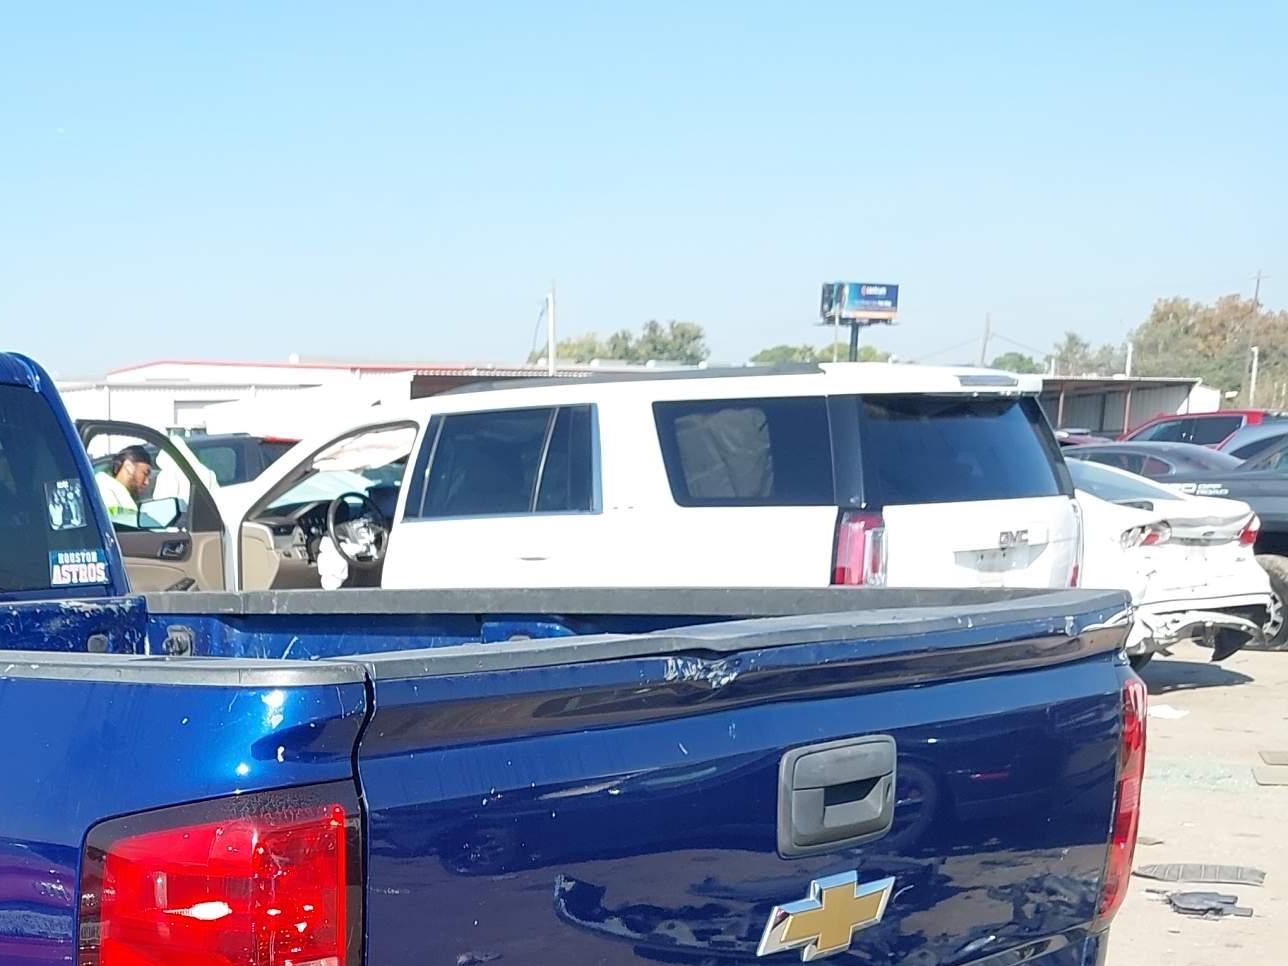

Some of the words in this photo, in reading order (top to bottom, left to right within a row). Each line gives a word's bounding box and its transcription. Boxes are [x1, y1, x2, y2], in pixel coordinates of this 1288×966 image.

[999, 529, 1029, 546] GMC
[57, 551, 98, 564] HOUSTON
[52, 562, 105, 585] ASTROS
